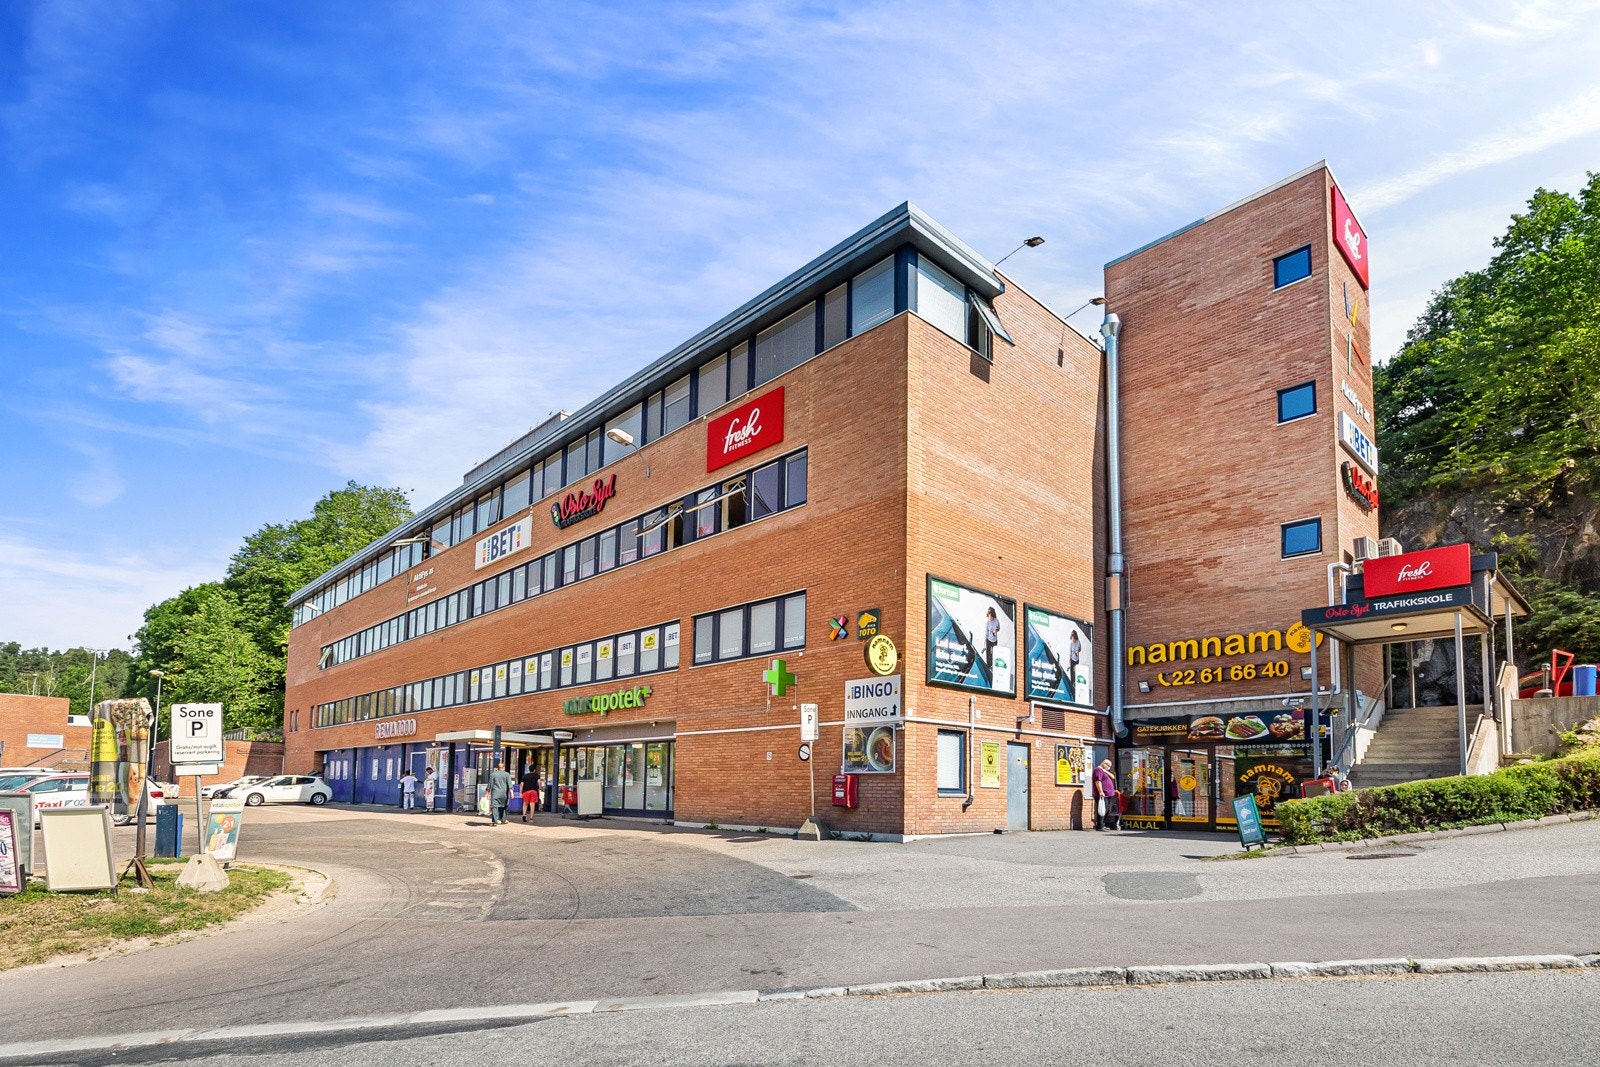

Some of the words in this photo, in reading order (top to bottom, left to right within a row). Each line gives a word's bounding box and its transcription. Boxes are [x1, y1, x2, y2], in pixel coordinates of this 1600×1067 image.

[723, 408, 762, 455] fresh
[728, 437, 752, 452] FITNESS
[1354, 427, 1370, 463] BET
[561, 491, 588, 520] Oslo
[589, 473, 617, 513] Syd
[491, 525, 517, 561] BET
[1397, 561, 1433, 583] fresh
[1325, 608, 1349, 619] Oslo
[1350, 603, 1370, 617] Syd
[1373, 593, 1454, 611] TRAFIKKSKOLE
[859, 627, 877, 637] TOTO
[1127, 629, 1283, 667] namnam
[1172, 669, 1196, 686] 22
[1200, 666, 1223, 684] 61
[1230, 663, 1256, 681] 66
[1262, 660, 1289, 678] 40
[179, 706, 214, 718] Sone
[807, 714, 813, 725] P
[847, 706, 888, 719] INNGANG
[191, 721, 204, 736] P
[375, 721, 397, 740] REMA
[397, 718, 417, 737] 1000
[1136, 724, 1188, 733] GATEKJØKKEN
[1239, 764, 1296, 785] namnam
[73, 799, 86, 807] 02
[1125, 820, 1160, 830] HALAL
